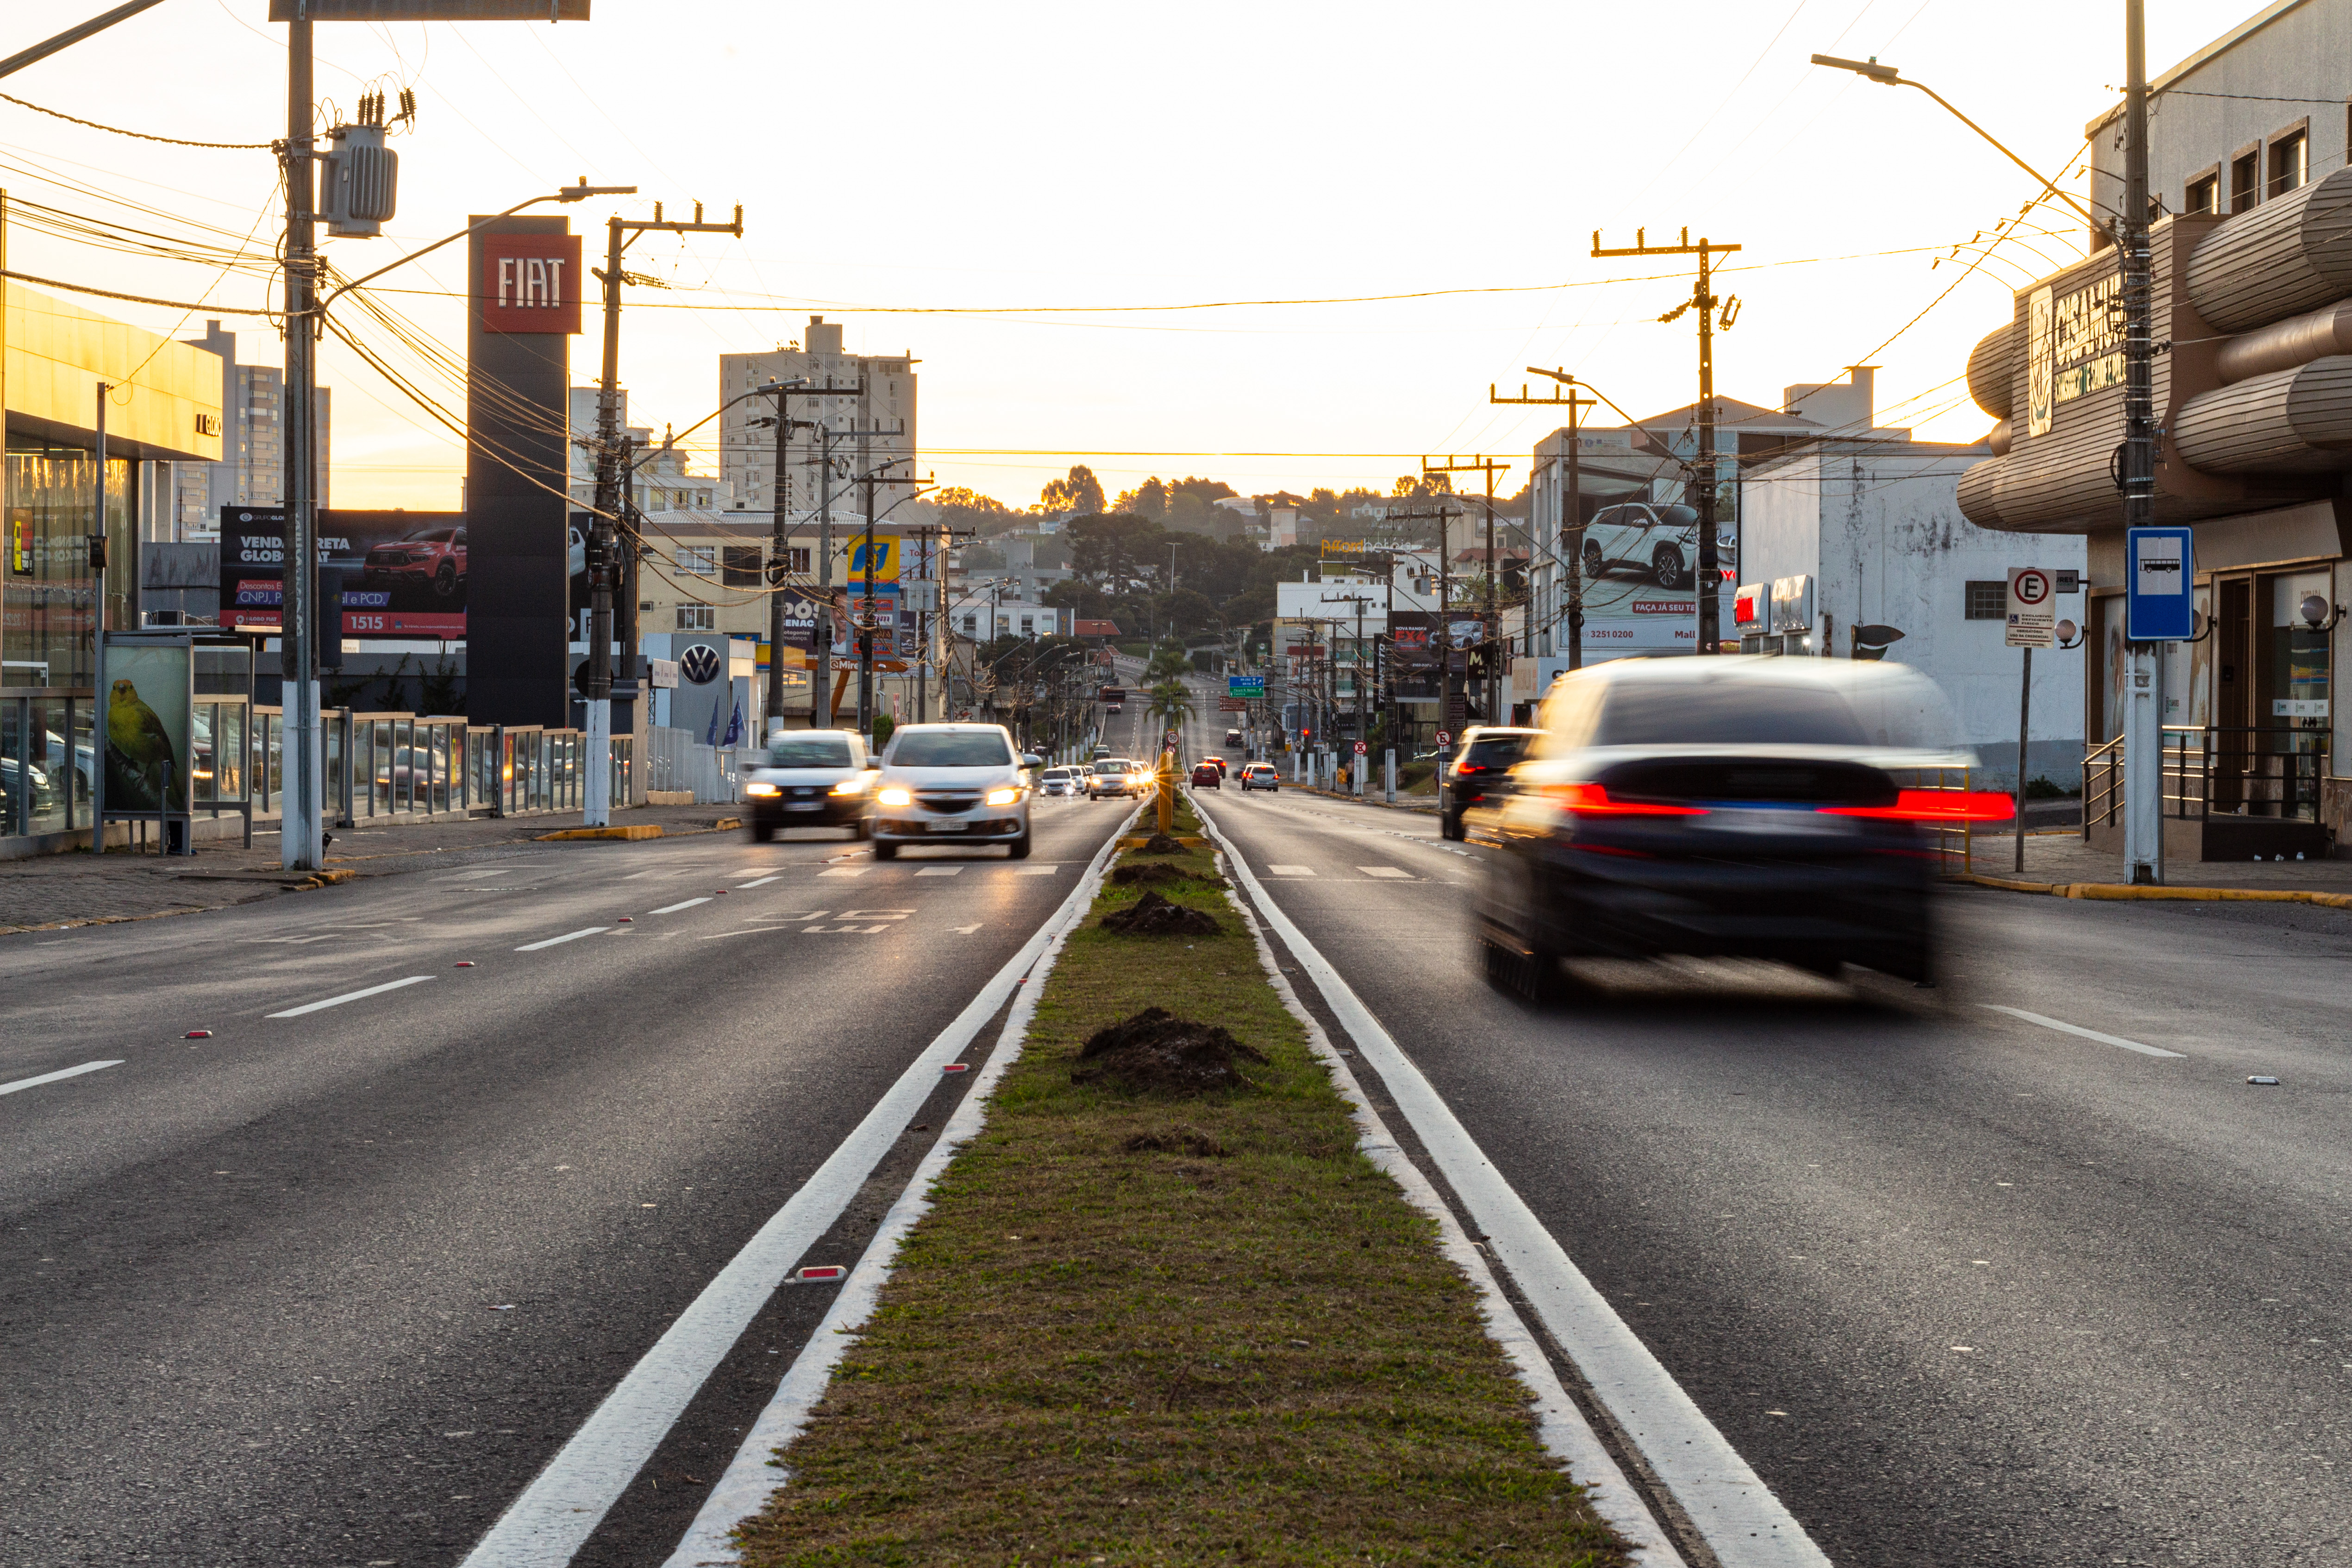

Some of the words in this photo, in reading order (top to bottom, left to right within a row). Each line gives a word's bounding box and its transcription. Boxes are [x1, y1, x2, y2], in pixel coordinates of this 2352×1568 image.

[498, 258, 565, 308] FIAT
[240, 536, 284, 548] VEND
[240, 550, 284, 562] GLOB
[2025, 577, 2039, 598] E
[240, 591, 271, 604] CNPJ,
[361, 593, 385, 605] PCD.
[1636, 604, 1656, 612] FAÇA
[1658, 603, 1667, 611] JÁ
[351, 616, 383, 630] 1515
[1395, 631, 1426, 643] FX4
